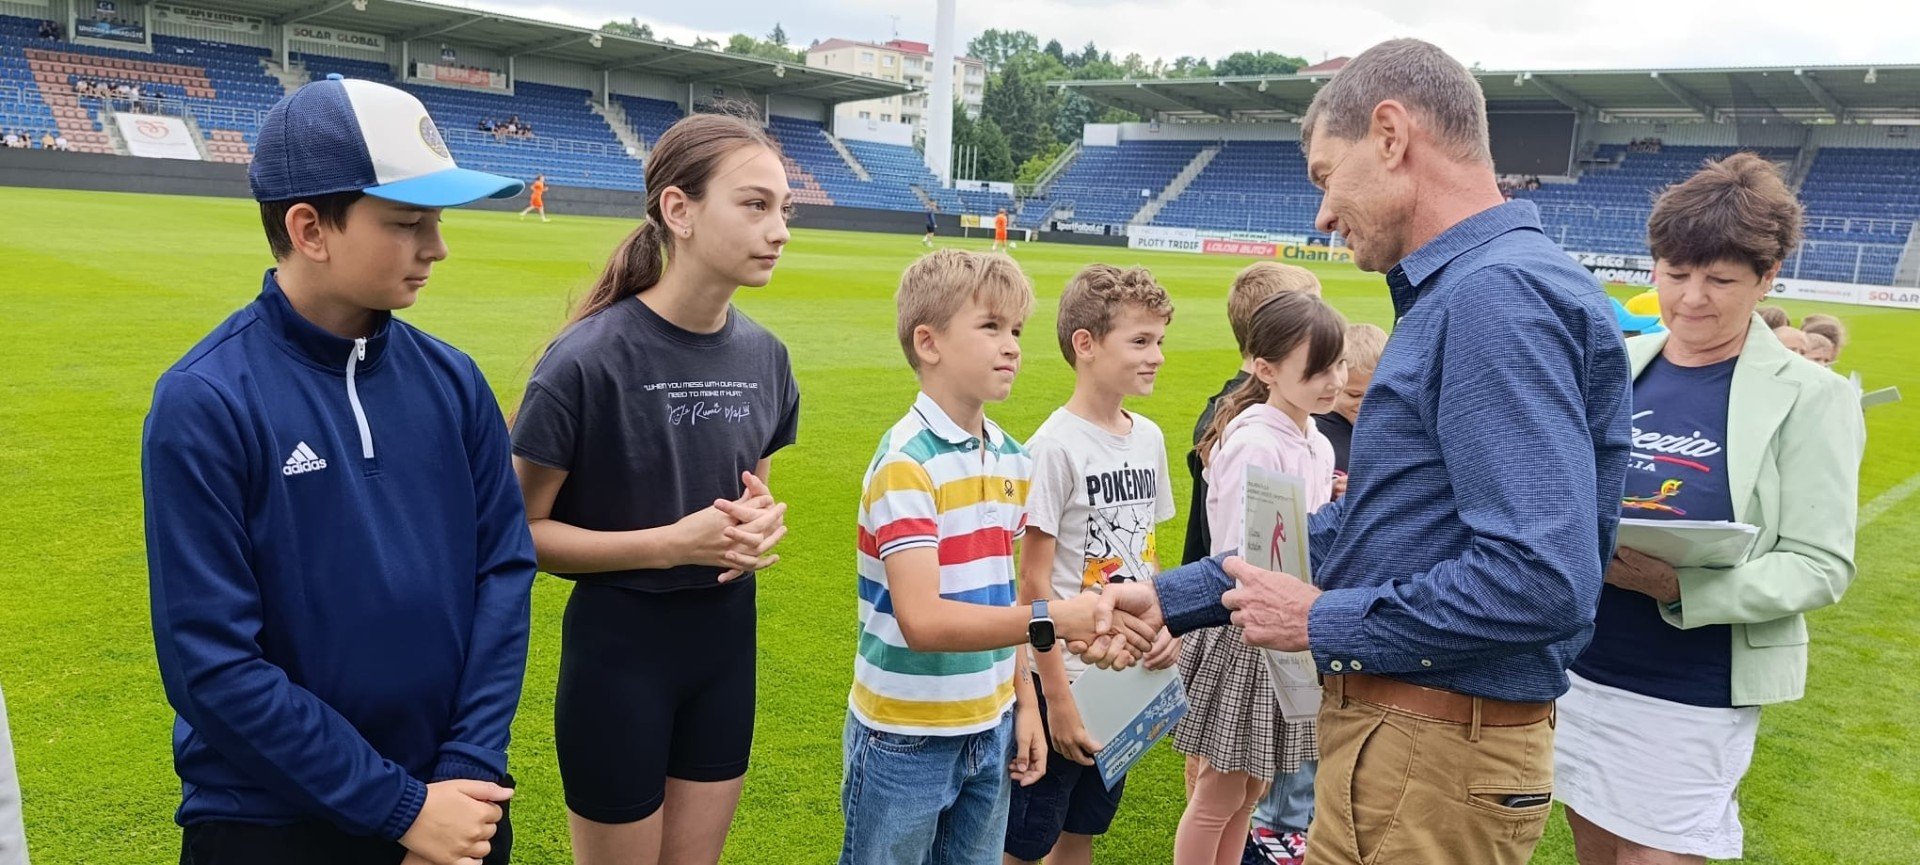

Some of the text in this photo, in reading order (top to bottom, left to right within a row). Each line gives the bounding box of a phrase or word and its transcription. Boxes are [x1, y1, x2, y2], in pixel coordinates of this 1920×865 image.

[293, 27, 380, 47] SOLAR GLOBAL
[1138, 238, 1165, 248] PLOTY
[1282, 241, 1351, 262] Chance
[1868, 291, 1920, 304] SOLAR
[283, 458, 327, 476] adidas
[1086, 461, 1157, 506] POKÉMON
